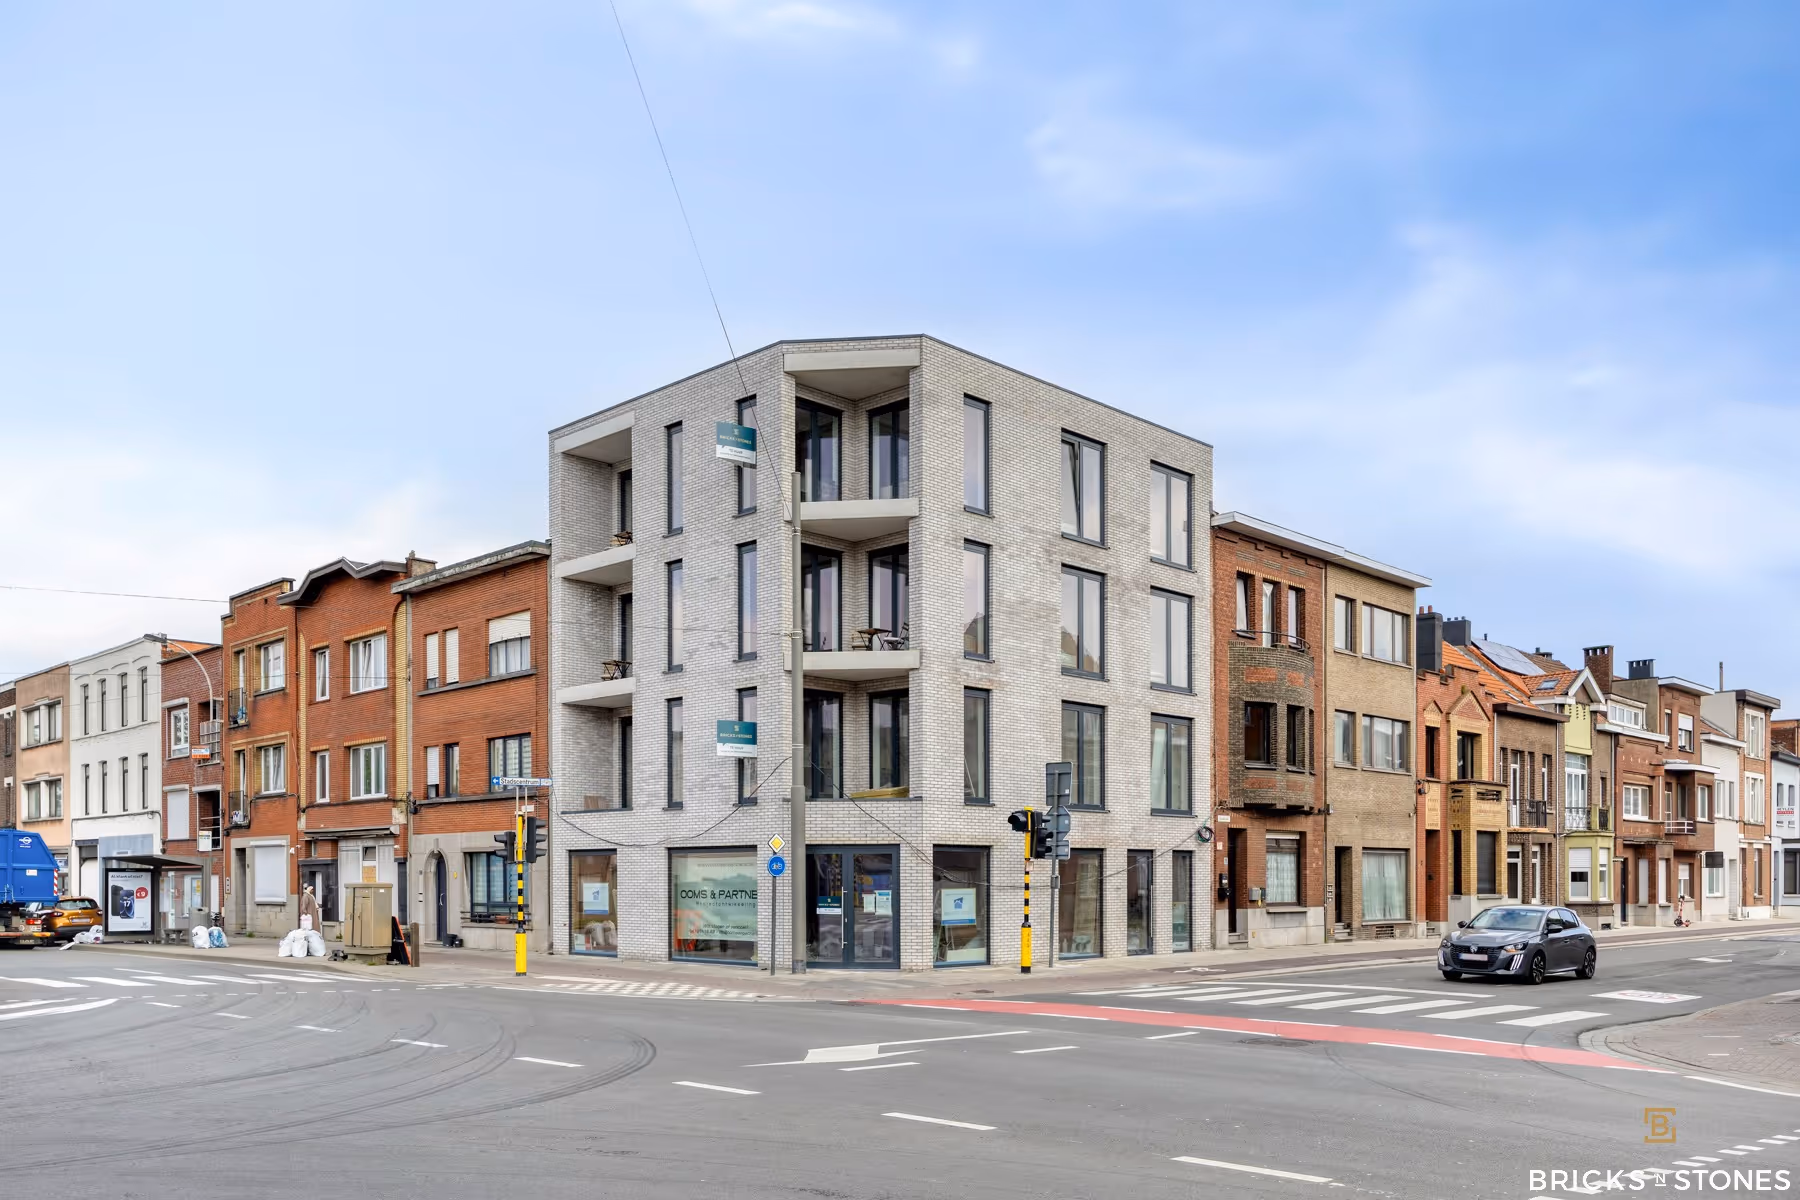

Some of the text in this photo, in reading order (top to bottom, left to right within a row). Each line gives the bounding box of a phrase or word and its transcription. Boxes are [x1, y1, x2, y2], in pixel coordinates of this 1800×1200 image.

[680, 890, 757, 899] OOMS & PARTNE
